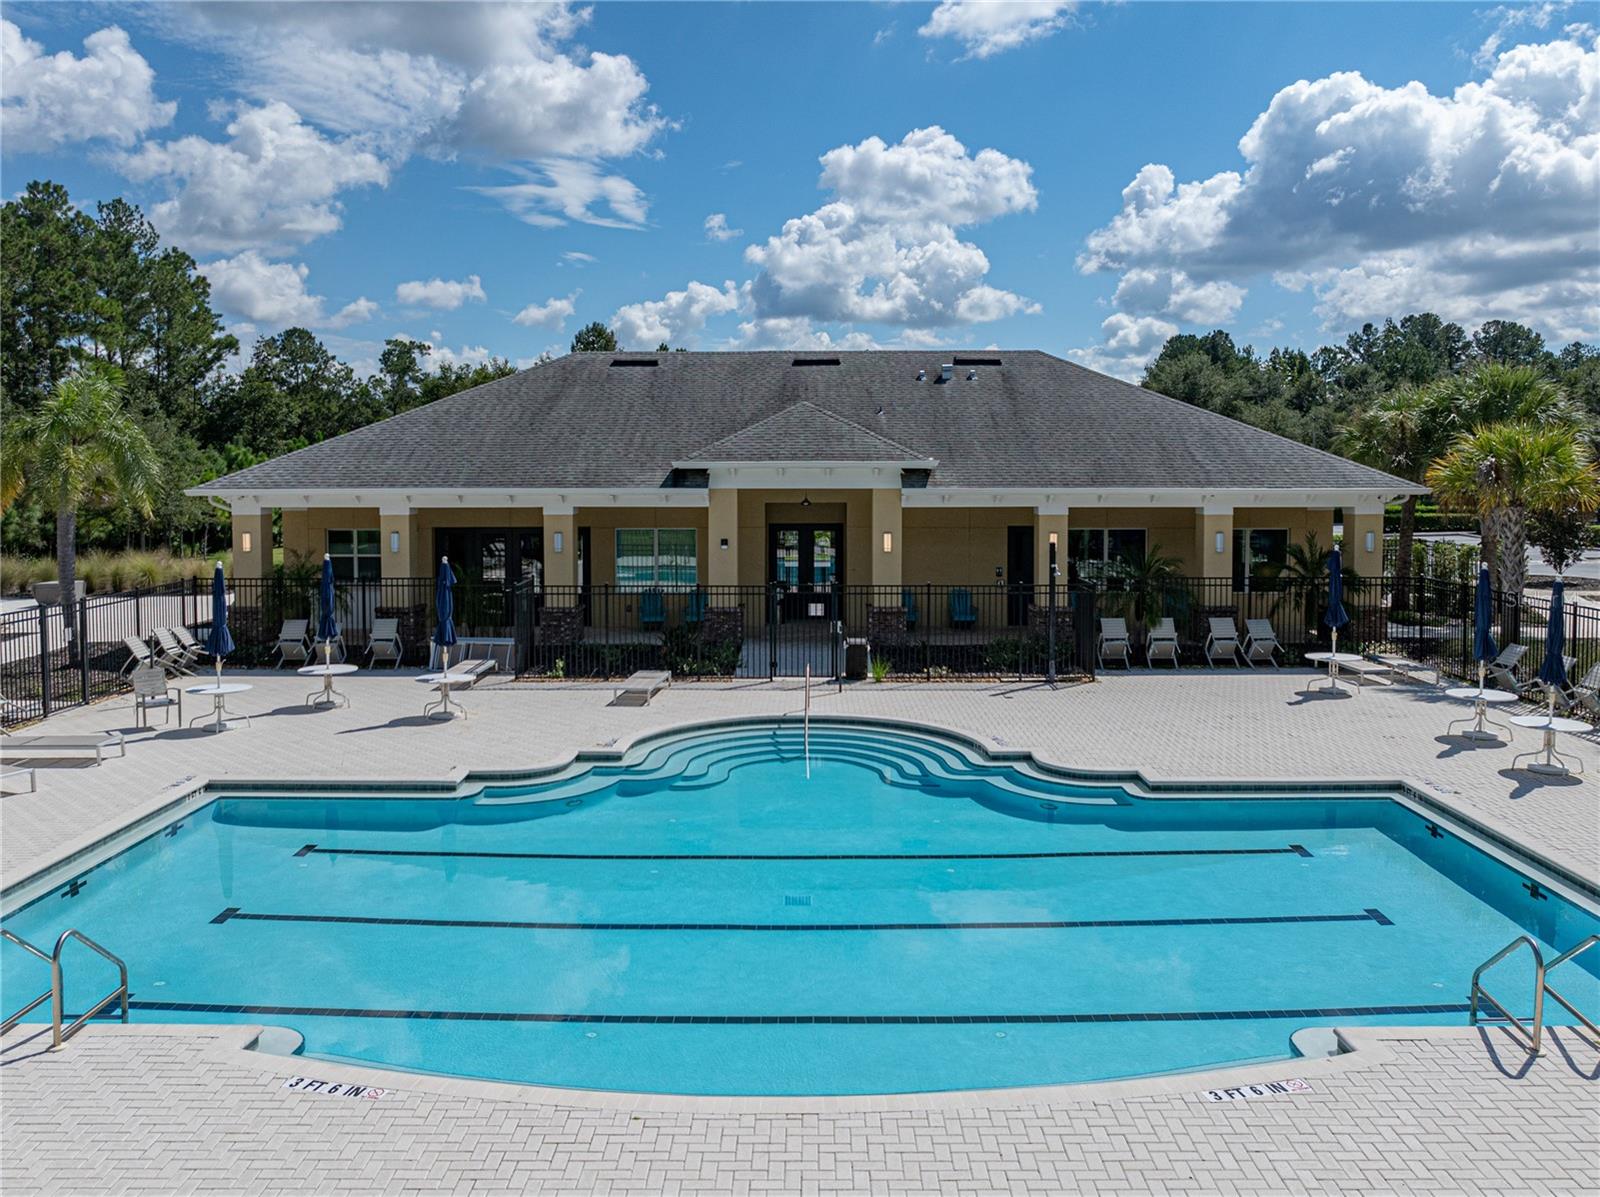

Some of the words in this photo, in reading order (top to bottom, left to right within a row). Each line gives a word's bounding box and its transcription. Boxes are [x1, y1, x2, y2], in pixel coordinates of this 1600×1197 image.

[289, 1078, 304, 1087] 3
[303, 1080, 328, 1091] FT
[328, 1084, 342, 1093] 6
[343, 1086, 366, 1097] IN
[1209, 1091, 1222, 1100] 3
[1224, 1088, 1246, 1099] FT
[1250, 1086, 1263, 1095] 6
[1264, 1083, 1288, 1093] IN
